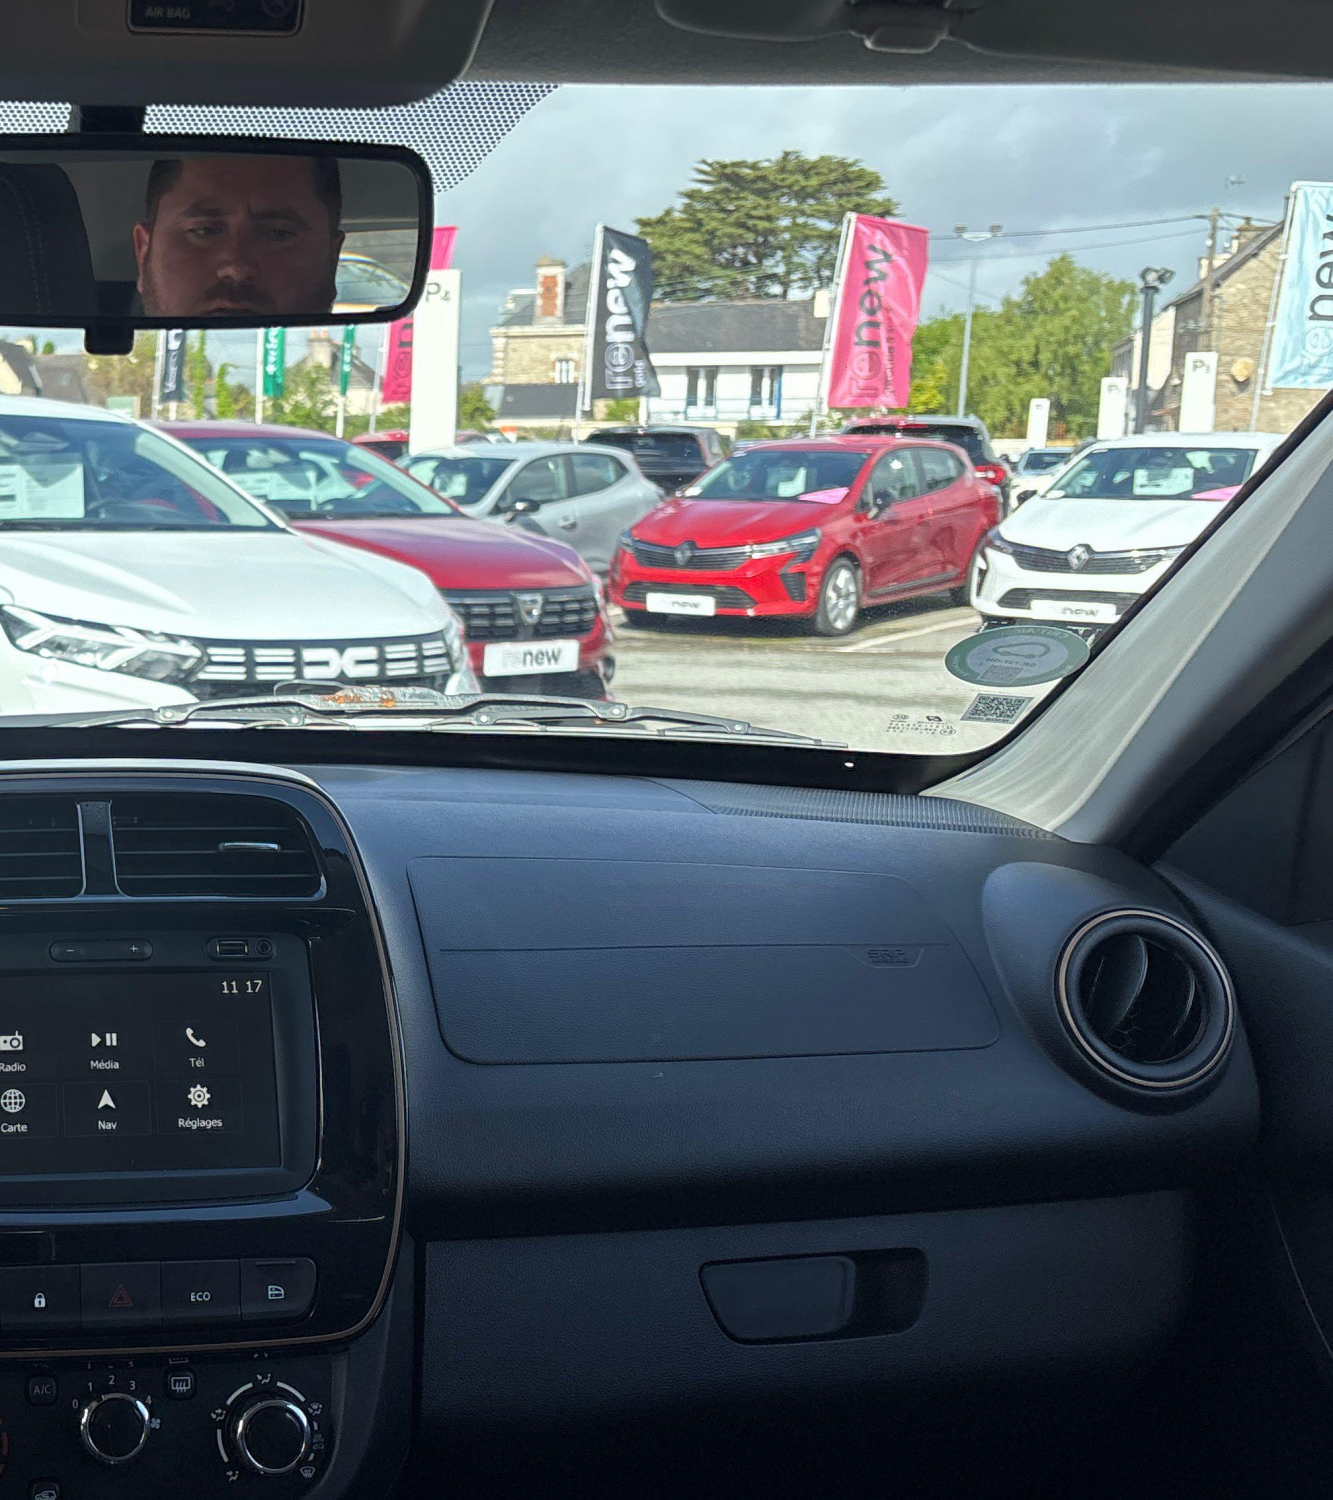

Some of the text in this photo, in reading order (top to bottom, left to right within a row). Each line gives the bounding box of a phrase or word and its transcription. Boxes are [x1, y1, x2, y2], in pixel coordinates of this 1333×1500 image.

[145, 7, 191, 19] AIR BAG
[221, 980, 263, 994] 11 17
[90, 1059, 120, 1071] Média
[188, 1057, 206, 1068] Tél
[0, 1122, 28, 1134] Carte
[97, 1120, 117, 1131] Nav
[178, 1116, 223, 1131] Réglages
[190, 1291, 211, 1303] ECO
[108, 1374, 116, 1385] 2
[129, 1380, 136, 1390] 3
[33, 1384, 51, 1395] A/C
[87, 1382, 93, 1392] 1
